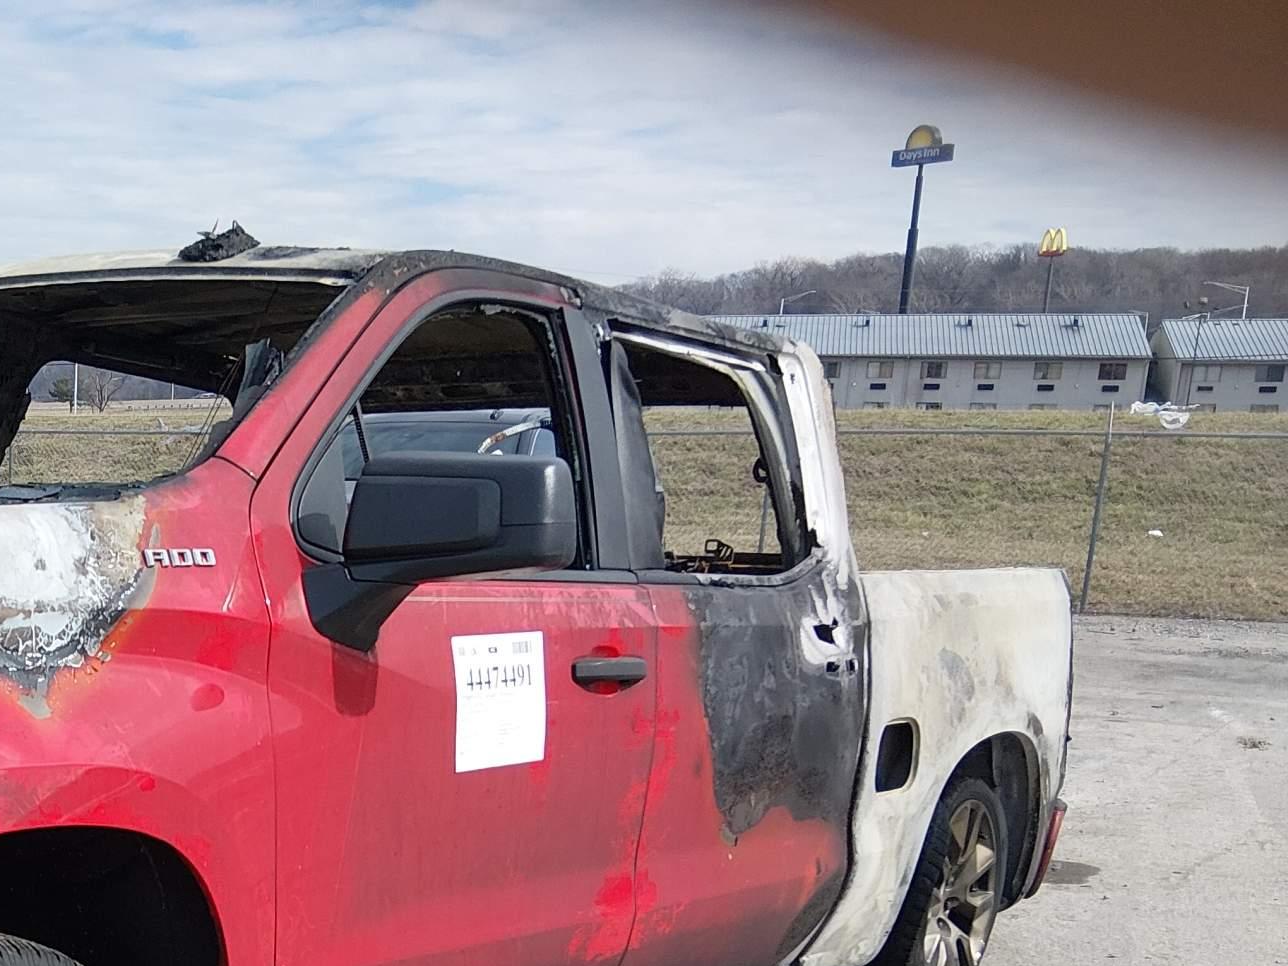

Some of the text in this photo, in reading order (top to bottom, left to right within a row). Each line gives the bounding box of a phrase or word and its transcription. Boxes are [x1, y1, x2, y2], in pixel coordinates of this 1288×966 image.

[899, 147, 940, 161] Days Inn
[467, 663, 533, 691] 44474491
